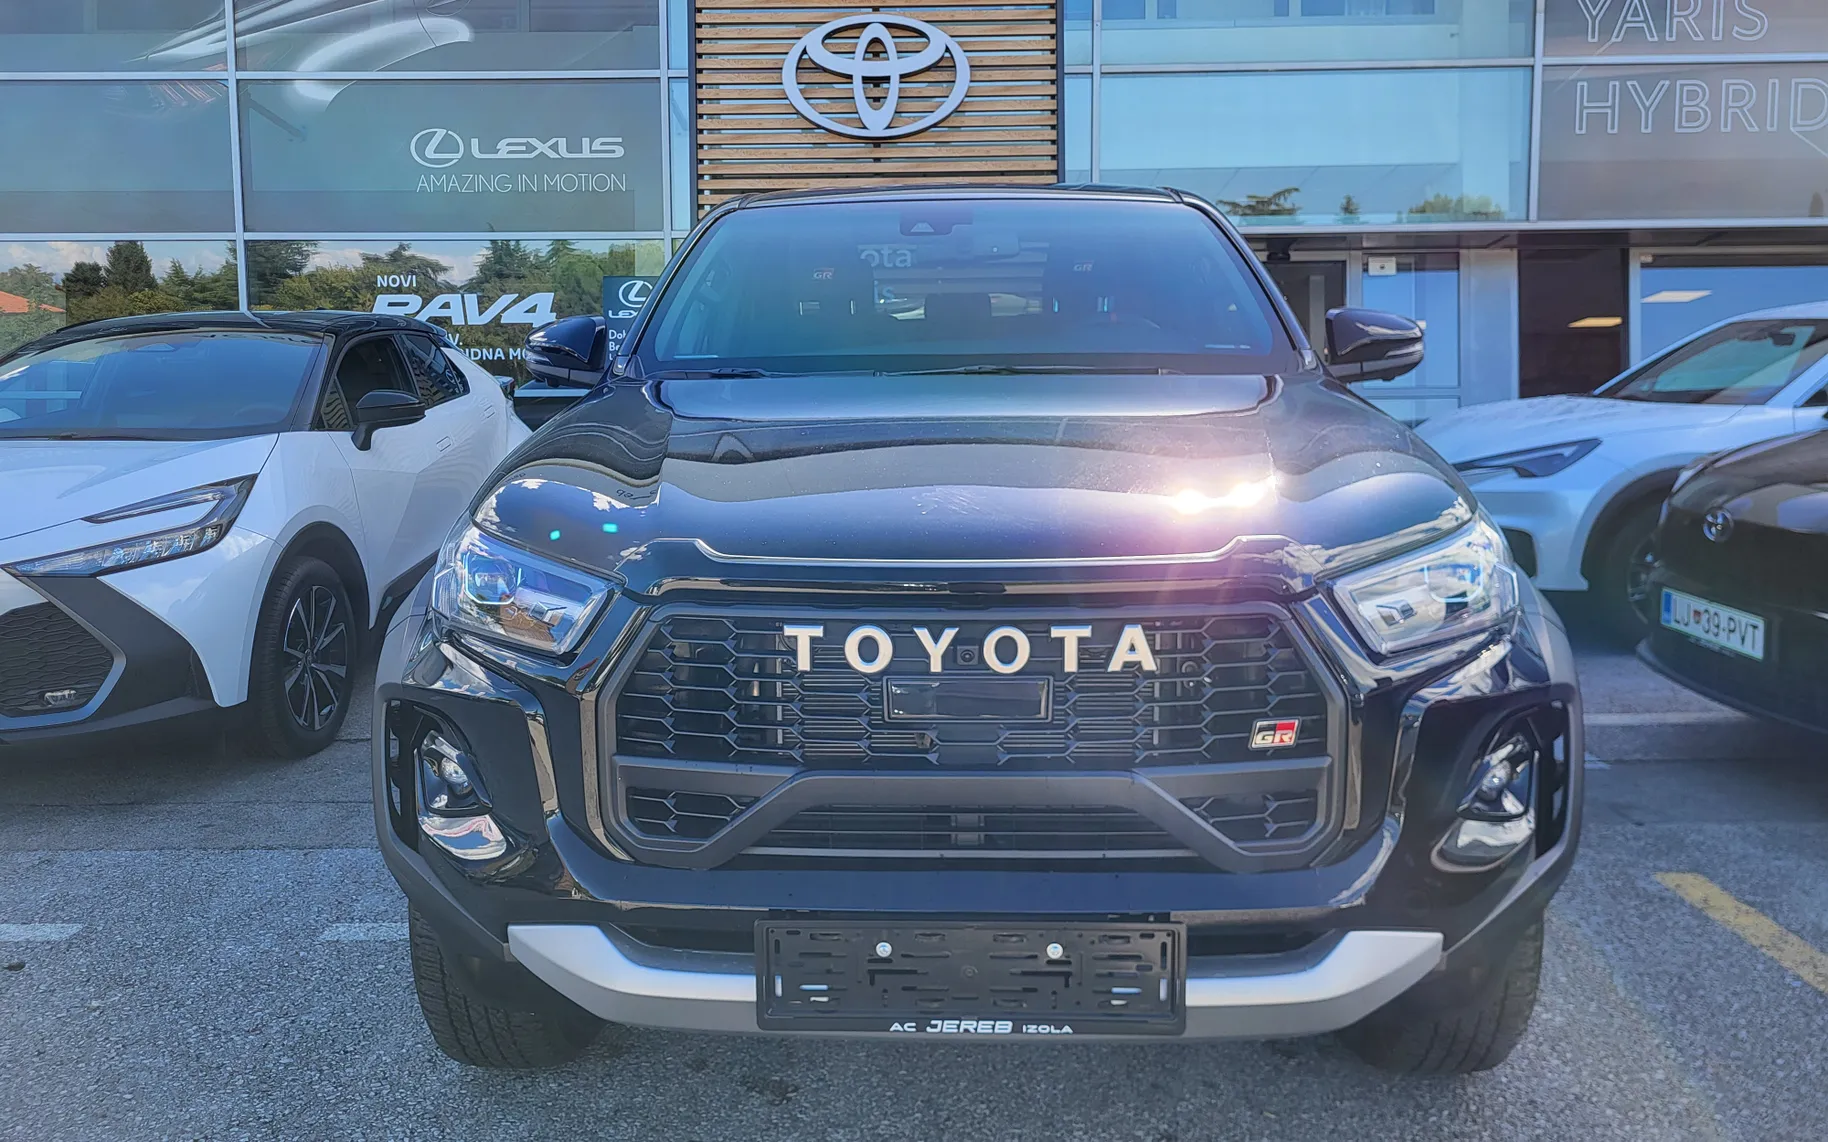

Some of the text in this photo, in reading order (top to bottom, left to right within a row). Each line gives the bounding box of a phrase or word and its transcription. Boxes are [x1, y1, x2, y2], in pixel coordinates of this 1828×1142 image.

[1578, 0, 1769, 42] YARIS
[1575, 78, 1828, 134] HYBRID
[470, 137, 625, 159] LEXUS
[416, 173, 627, 193] AMAZING IN MOTION
[860, 246, 912, 268] ota
[812, 271, 833, 280] GR
[1073, 263, 1093, 272] GR
[376, 275, 417, 288] NOVI
[873, 280, 896, 304] is
[372, 292, 557, 328] RAV4
[608, 310, 639, 319] LEX
[448, 333, 463, 346] V.
[463, 347, 505, 360] IDNA
[1674, 597, 1692, 627] LJ
[783, 624, 1158, 674] TOYOTA
[1255, 730, 1294, 745] GR
[889, 1020, 1073, 1034] AC JEREB IZOLA
